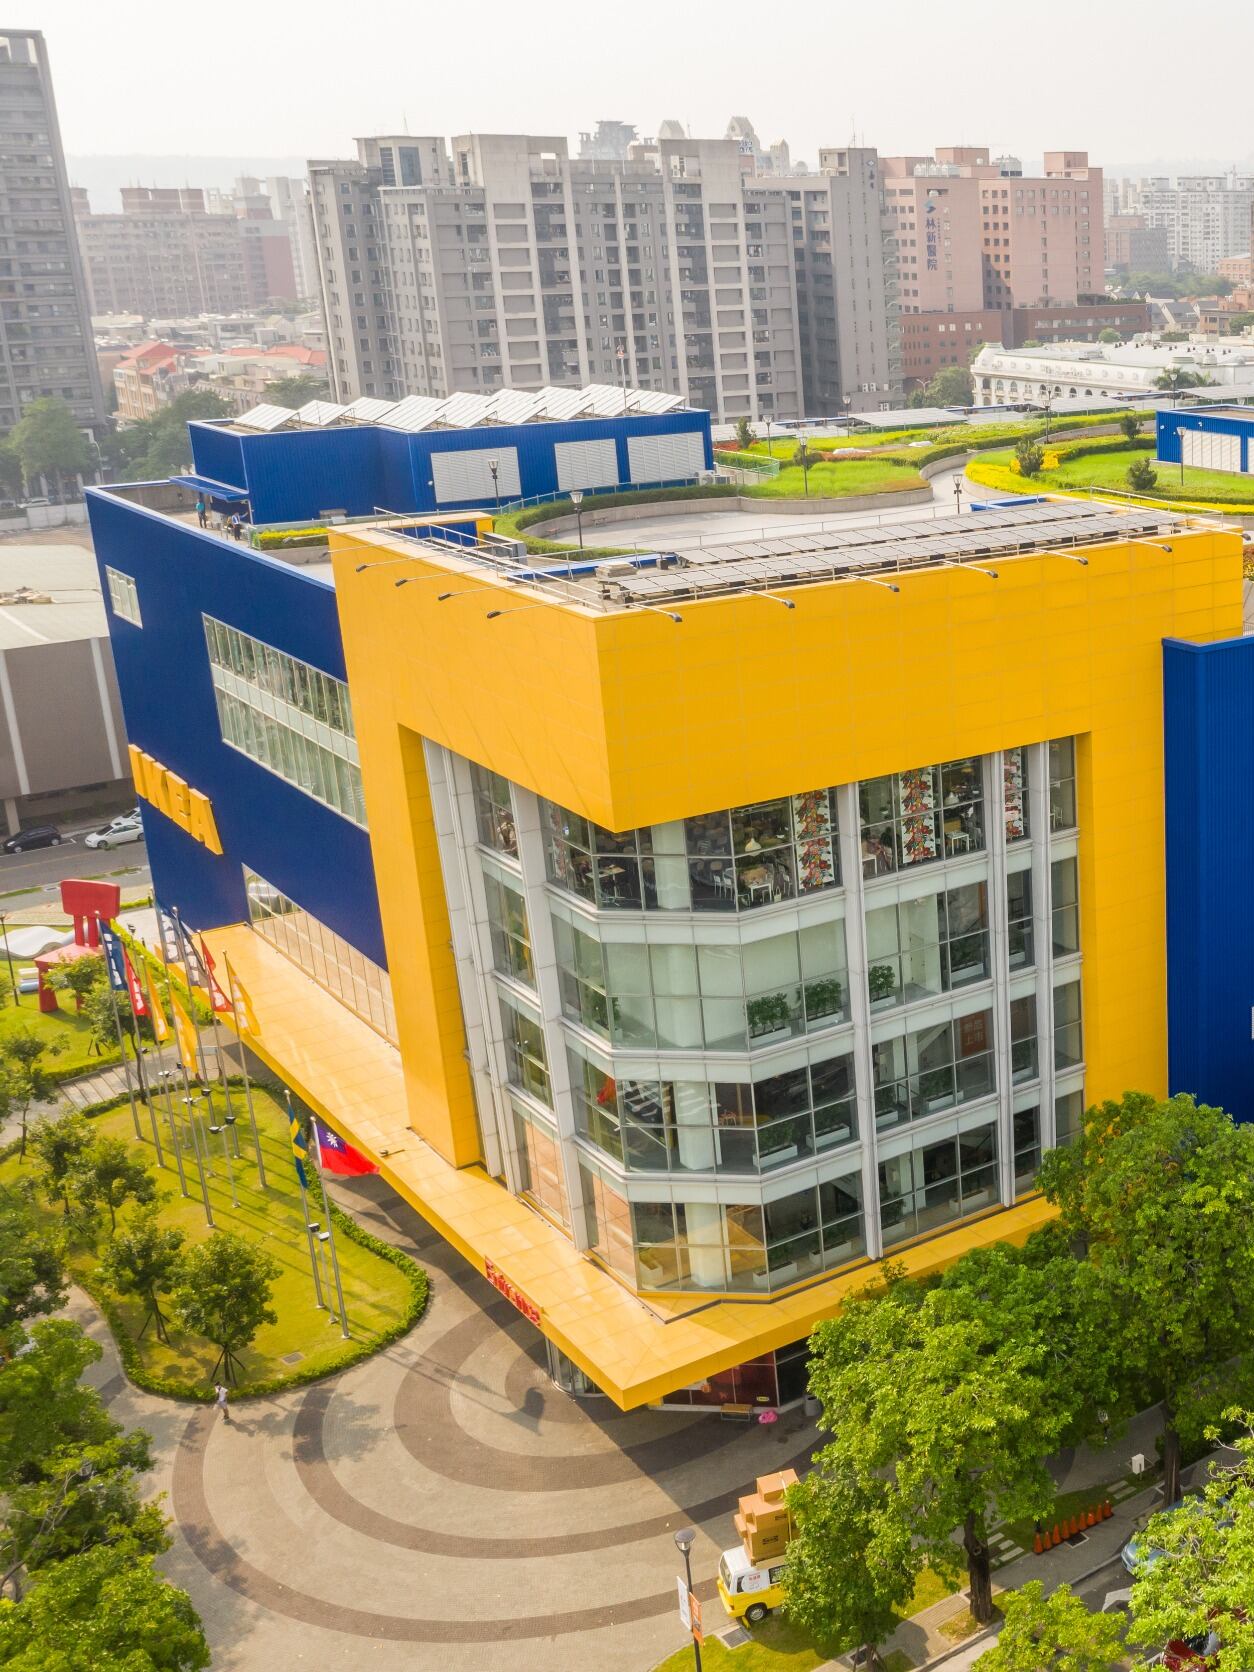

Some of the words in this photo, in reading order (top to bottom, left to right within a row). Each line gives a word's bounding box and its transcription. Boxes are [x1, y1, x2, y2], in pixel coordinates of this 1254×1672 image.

[926, 218, 937, 271] 林新醫院
[128, 744, 224, 855] IKEA
